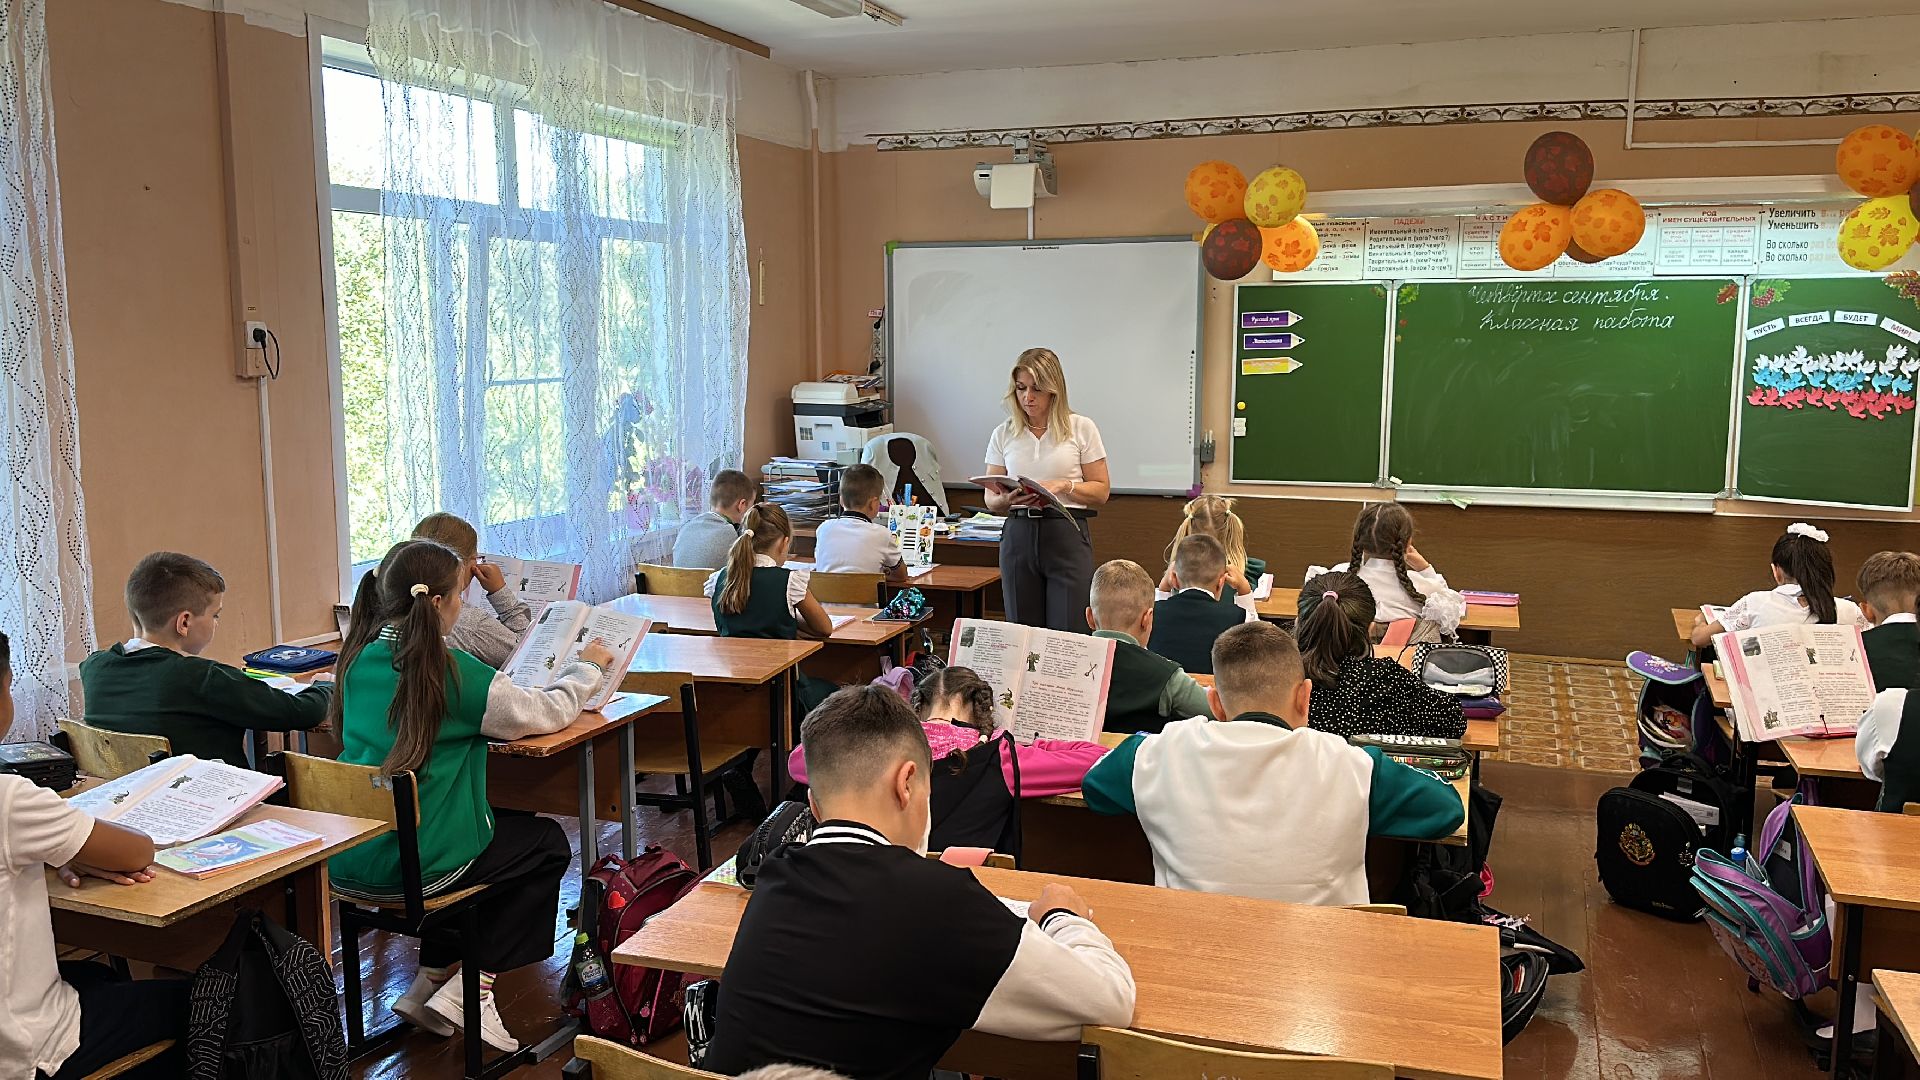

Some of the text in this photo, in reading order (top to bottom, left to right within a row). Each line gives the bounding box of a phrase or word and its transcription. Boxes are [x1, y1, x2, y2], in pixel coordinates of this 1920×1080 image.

[1769, 208, 1816, 218] Увеличить
[1768, 219, 1819, 230] Уменьшить
[1766, 239, 1776, 249] Во
[1778, 240, 1809, 249] сколько
[1765, 251, 1775, 262] Во
[1777, 253, 1808, 262] сколько
[1479, 309, 1580, 332] Классная
[1753, 313, 1912, 338] ПУСТЬ ВСЕГДА БУДЕТ МИР!
